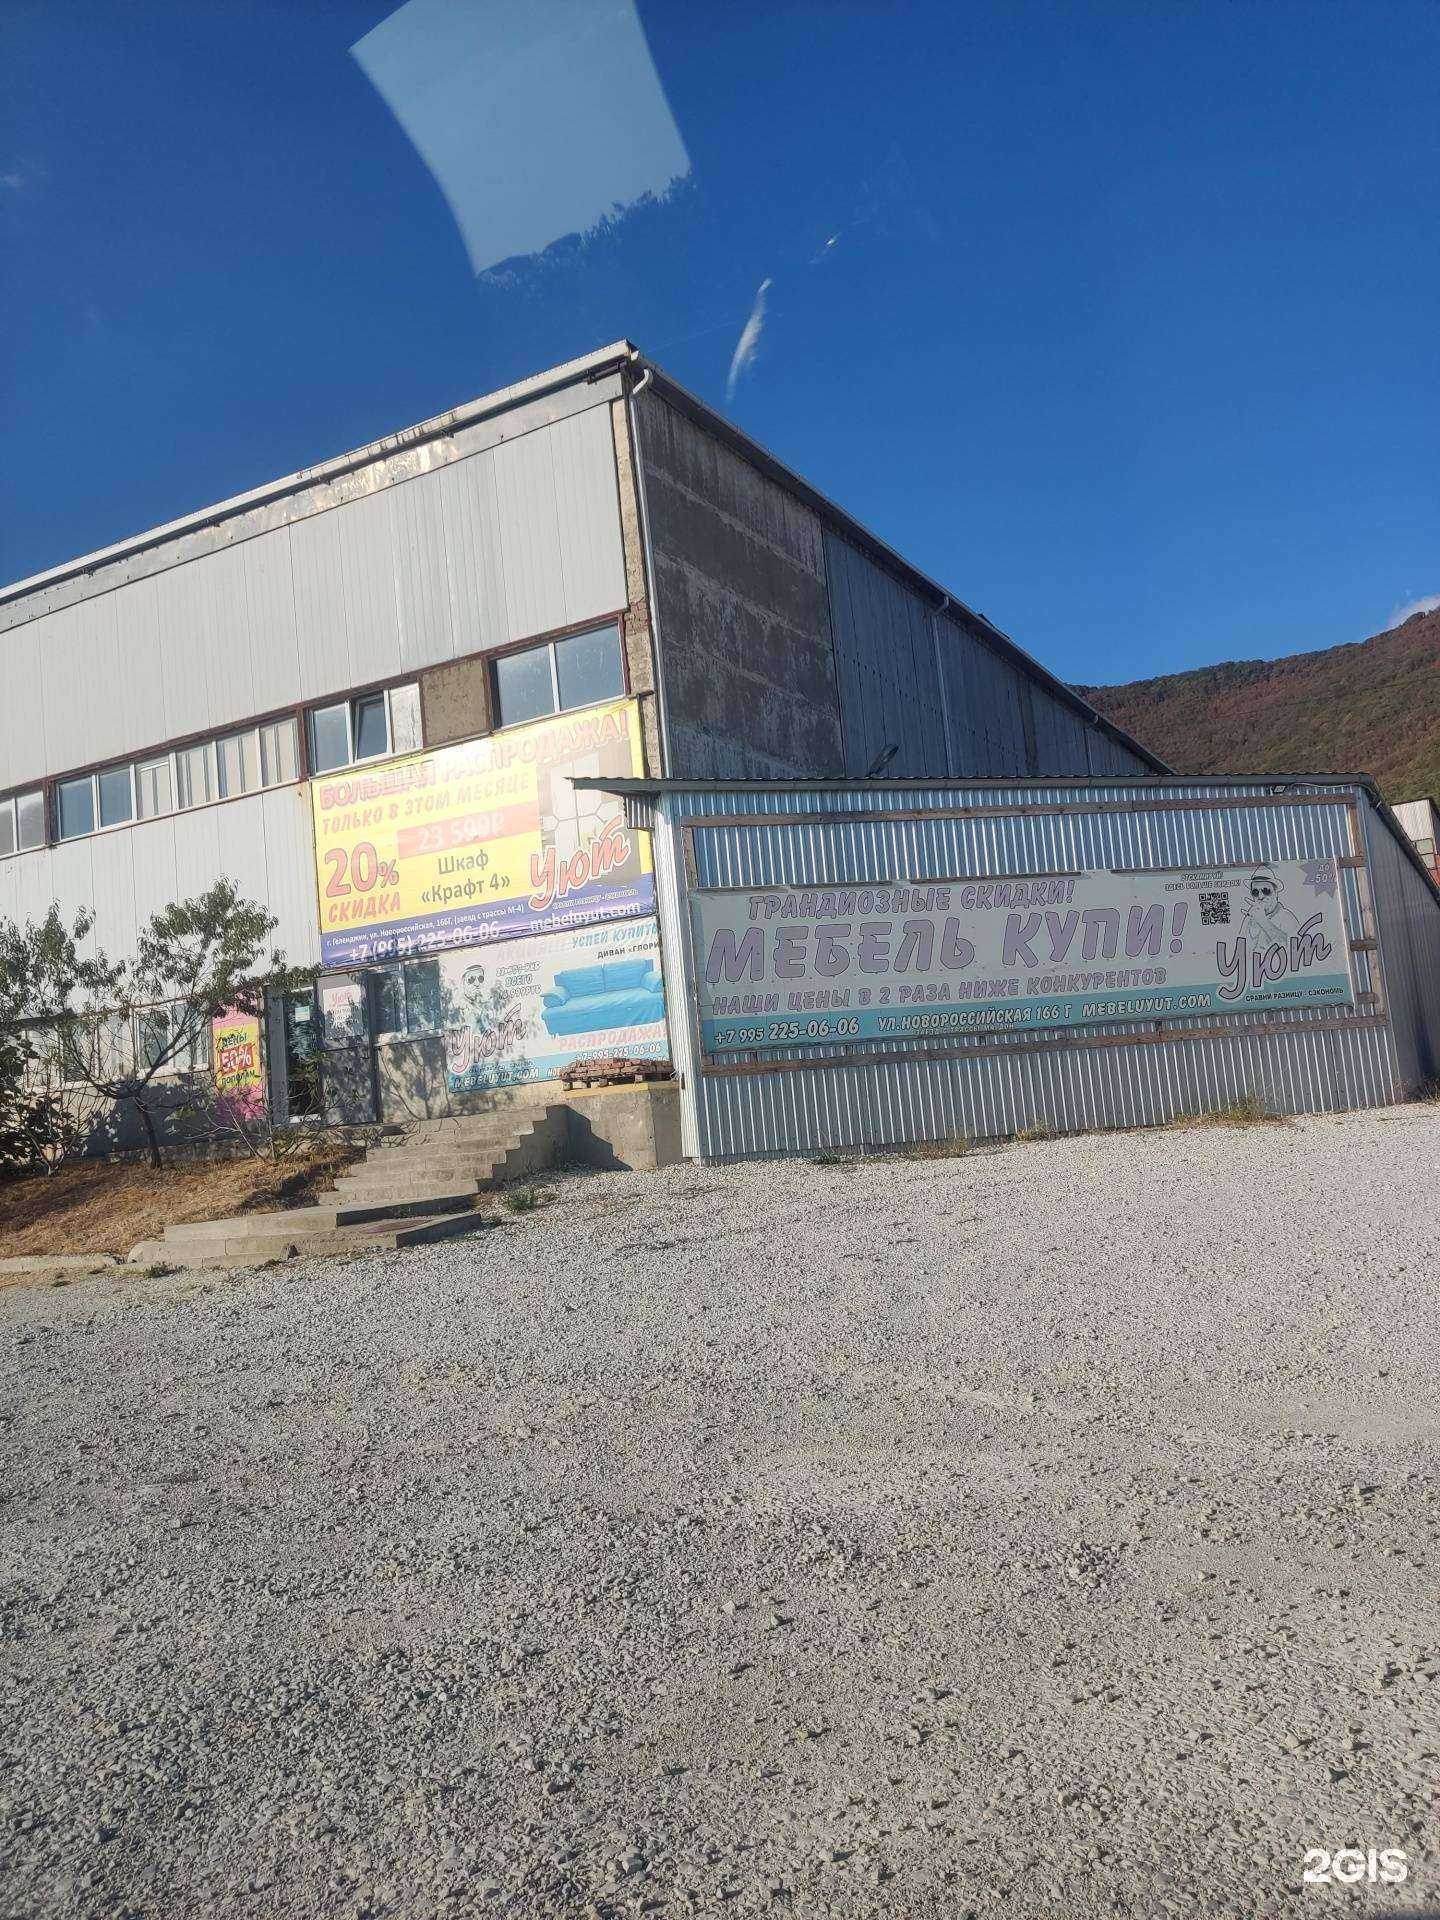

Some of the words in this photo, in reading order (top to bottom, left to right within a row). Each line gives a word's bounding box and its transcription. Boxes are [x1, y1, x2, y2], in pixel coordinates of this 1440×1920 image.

[442, 709, 630, 783] РАСПРОДАЖА!
[322, 805, 383, 835] ТОЛЬКО
[390, 803, 399, 821] В
[405, 791, 450, 816] ЭТОМ
[457, 773, 529, 804] МЕСЯЦЕ
[418, 825, 444, 850] 23
[325, 842, 400, 898] 20%
[438, 849, 489, 874] Шкаф
[529, 814, 630, 910] Уют
[421, 878, 485, 904] «Крафт
[490, 873, 511, 890] 4»
[749, 888, 951, 920] ГРАНДИОЗНЫЕ
[961, 880, 1076, 909] СКИДКИ!
[328, 892, 400, 923] СКИДКА
[350, 943, 369, 961] +7
[598, 947, 625, 960] ДИВАН
[705, 917, 976, 983] МЕБЕЛЬ
[1001, 902, 1188, 968] КУПИ!
[1217, 912, 1332, 1000] Уют
[712, 993, 780, 1015] НАШИ
[787, 989, 850, 1012] ЦЕНЫ
[858, 988, 872, 1006] В
[879, 986, 891, 1004] 2
[899, 983, 950, 1003] РАЗА
[958, 979, 1020, 1000] НИЖЕ
[1026, 968, 1167, 995] КОНКУРЕНТОВ
[1082, 994, 1211, 1019] MEBELUYUT.COM
[1245, 993, 1272, 1002] СРАВНИ
[1308, 986, 1344, 996] СЭКОНОМЬ
[1035, 1005, 1060, 1020] 166
[450, 1002, 527, 1074] Уют
[715, 1031, 735, 1043] +7
[739, 1028, 765, 1042] 995
[768, 1017, 860, 1040] 225-06-06
